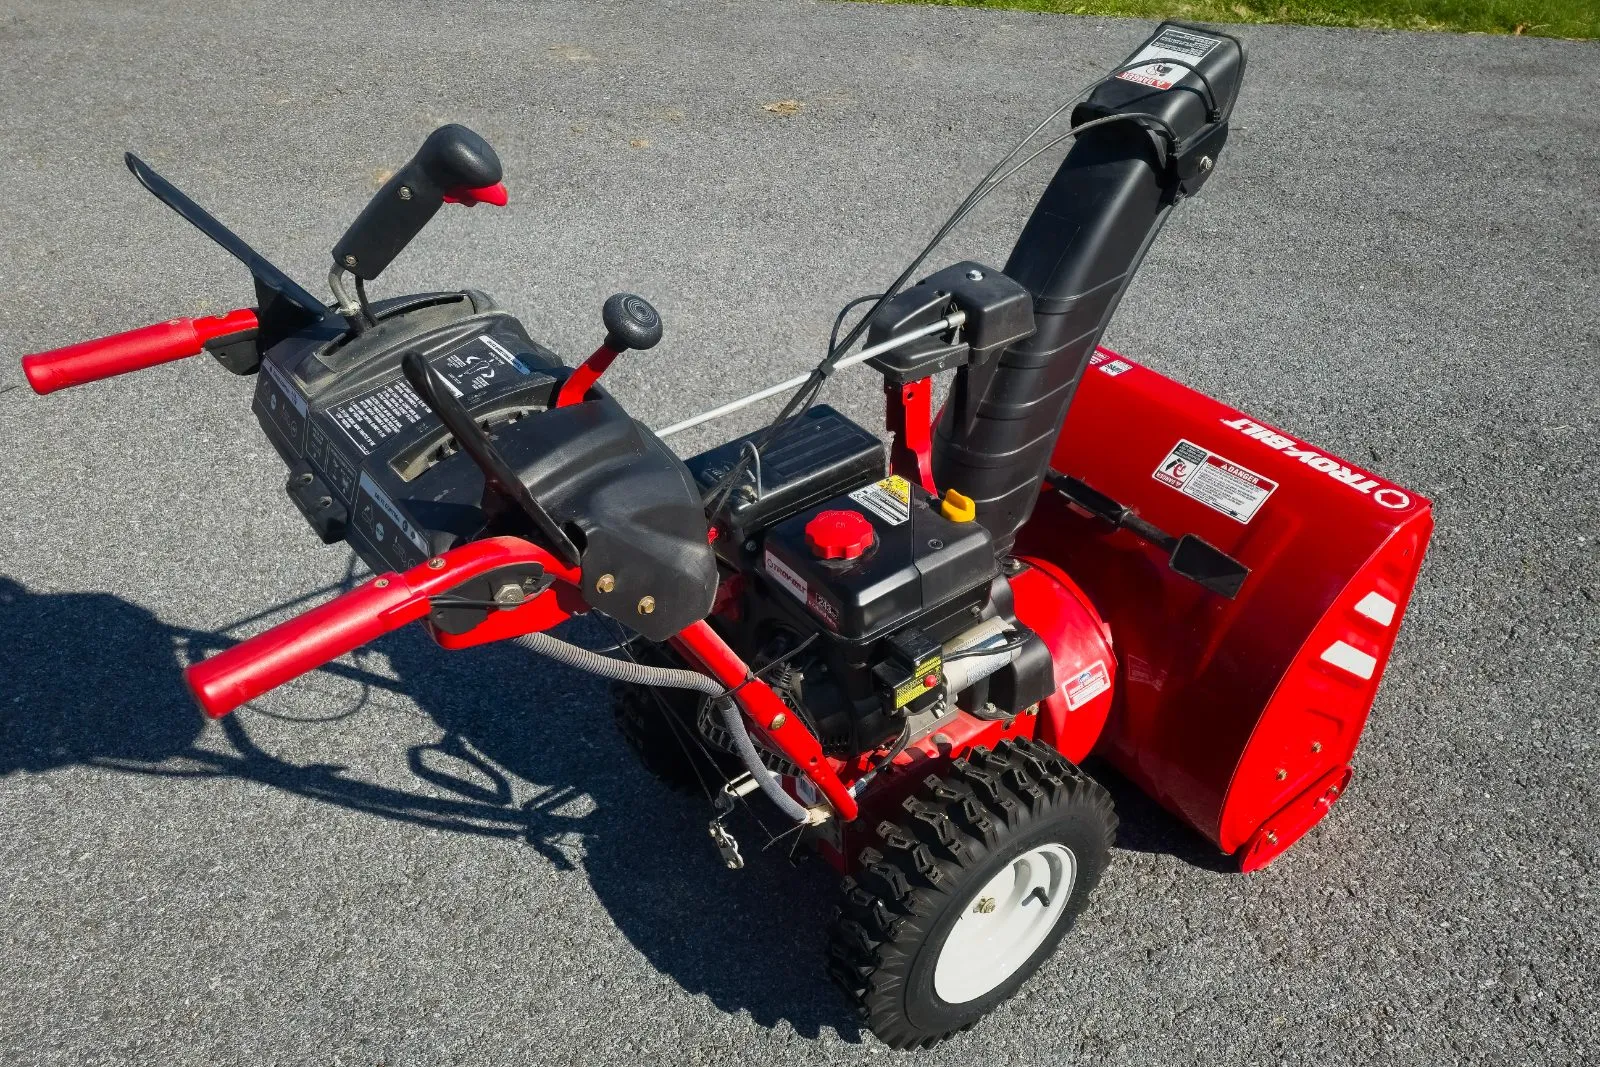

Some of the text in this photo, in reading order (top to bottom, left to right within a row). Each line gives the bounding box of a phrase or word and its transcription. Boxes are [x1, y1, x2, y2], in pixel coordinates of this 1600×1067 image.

[1121, 71, 1153, 86] DANGER
[1222, 418, 1381, 494] TROY-BILT
[1226, 465, 1260, 485] DANGER
[772, 563, 807, 593] TROY-BILT
